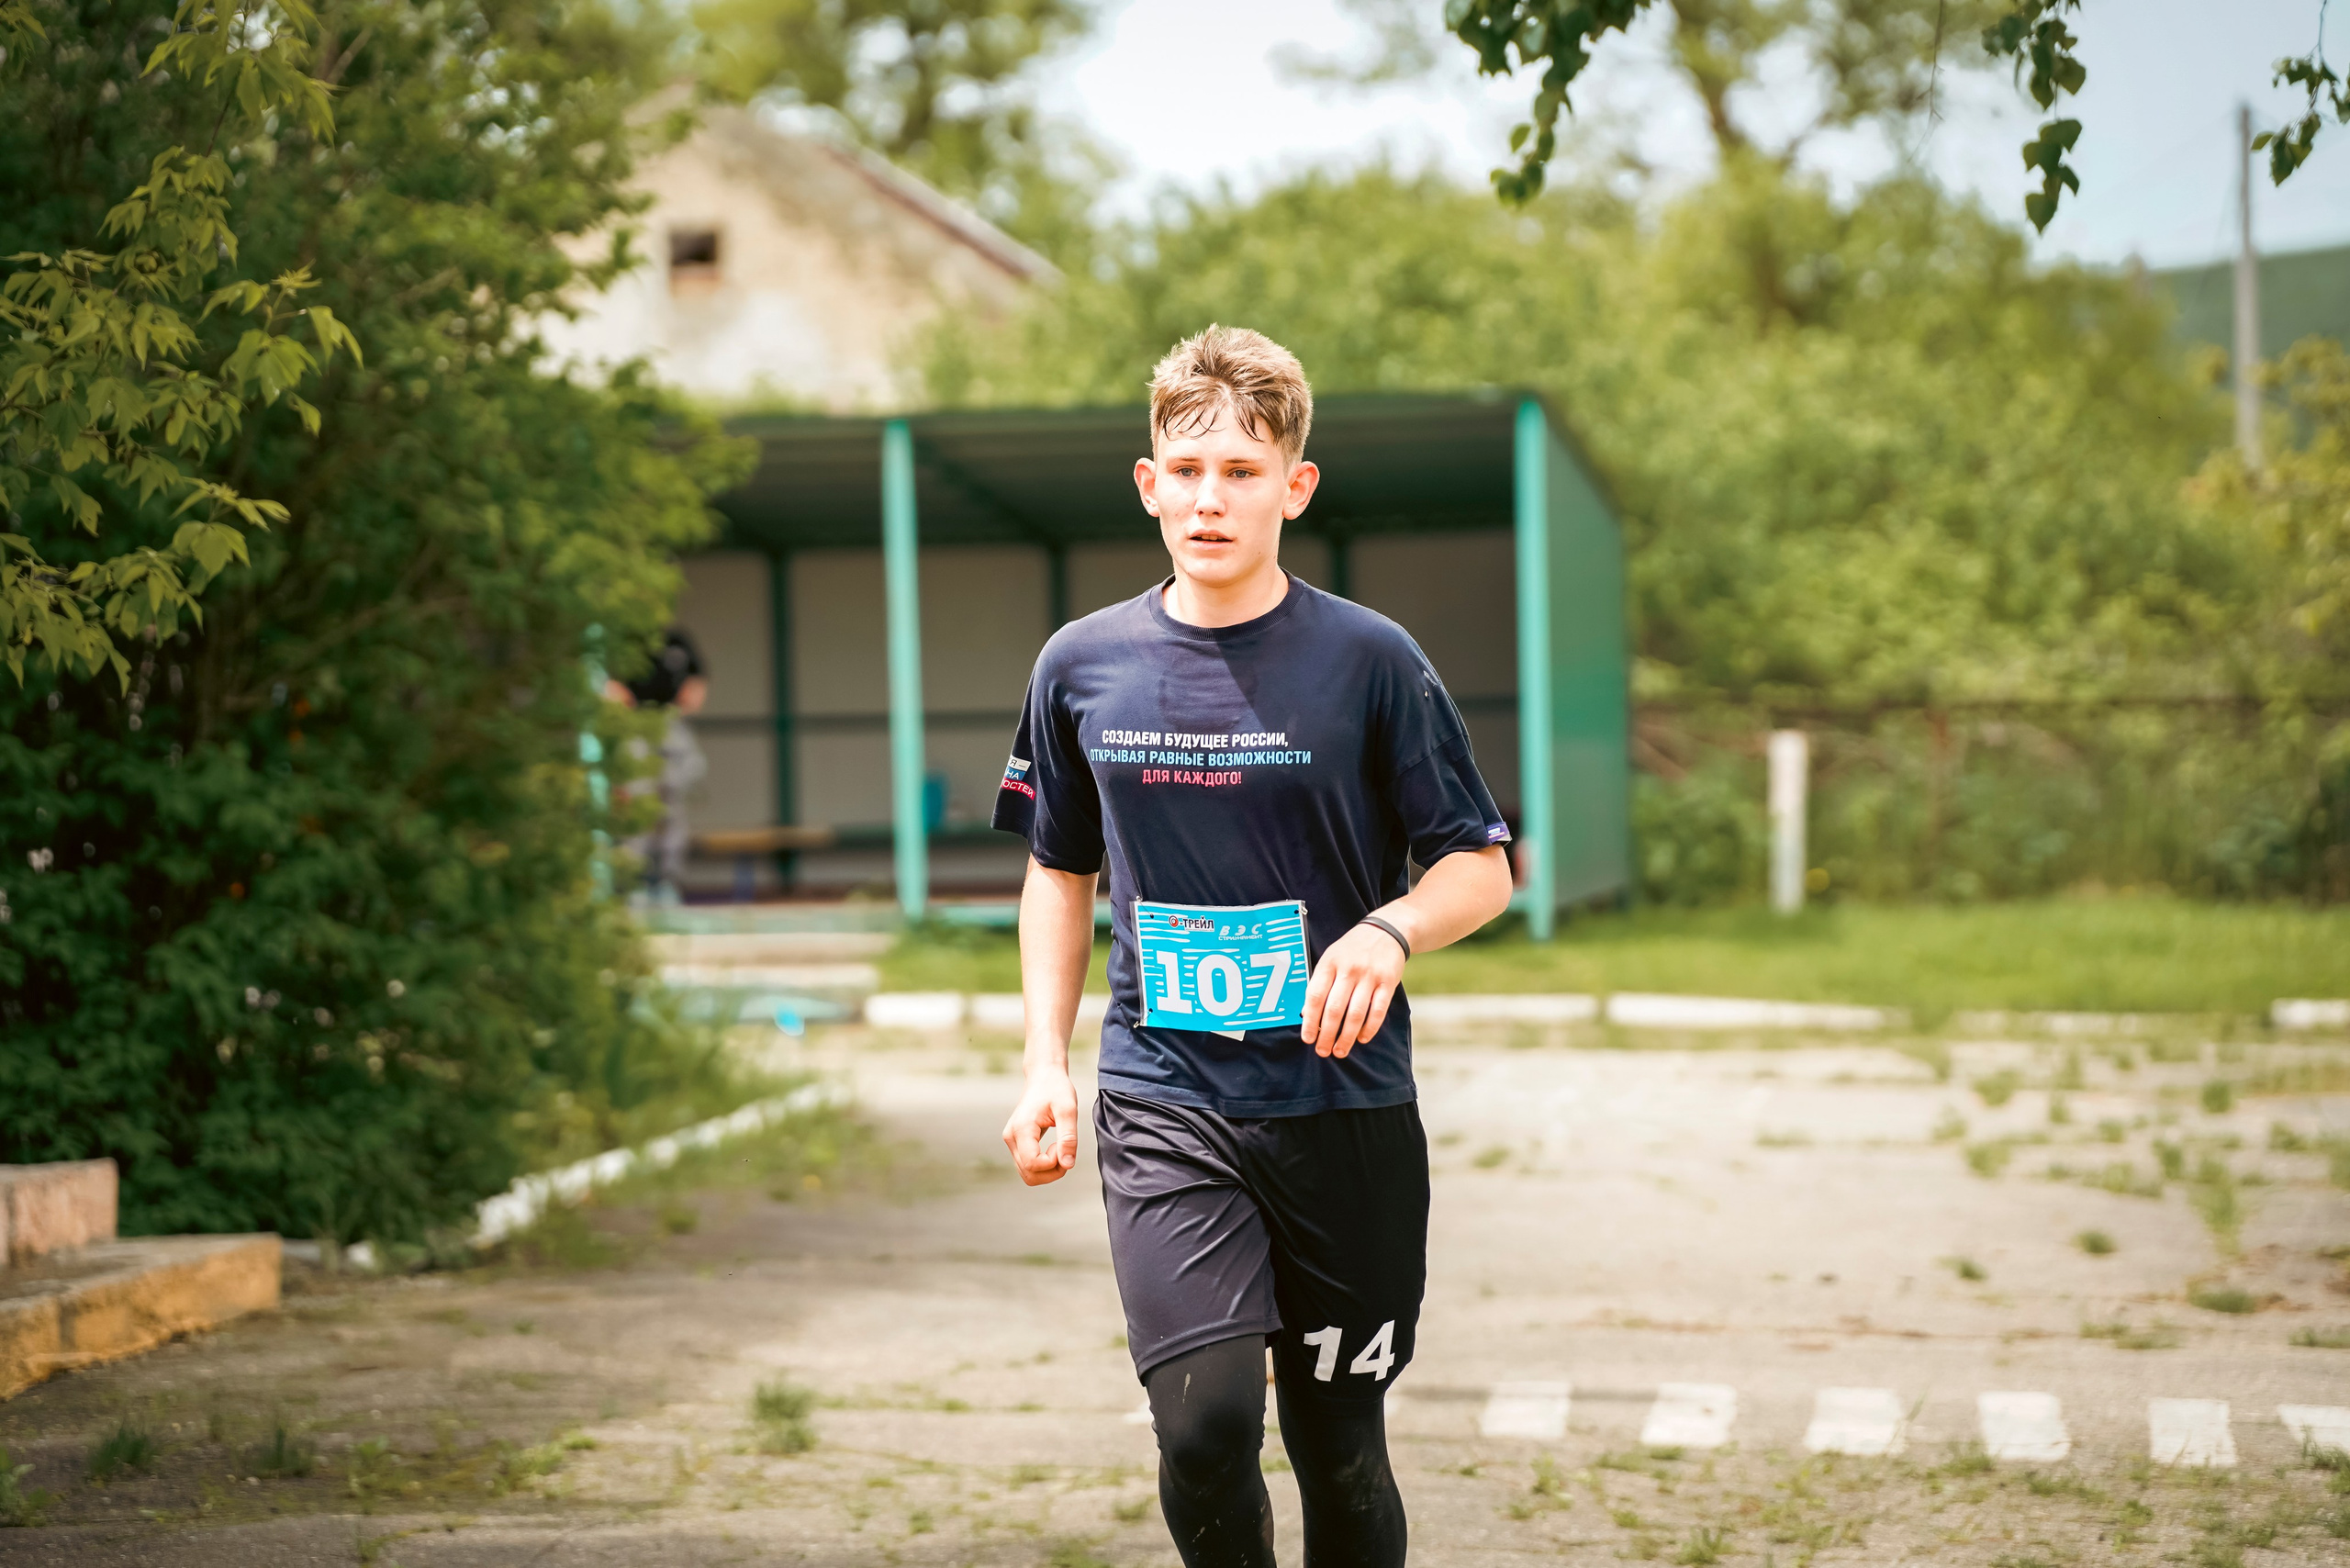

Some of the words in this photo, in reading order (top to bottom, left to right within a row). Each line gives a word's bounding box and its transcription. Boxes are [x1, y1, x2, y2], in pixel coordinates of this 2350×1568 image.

[1102, 730, 1161, 746] СОЗДАЕМ
[1164, 733, 1228, 750] БУДУЩЕЕ
[1231, 732, 1289, 747] РОССИИ,
[1090, 748, 1146, 764] ОТКРЫВАЯ
[1149, 750, 1204, 767] РАВНЫЕ
[1208, 750, 1312, 767] ВОЗМОЖНОСТИ
[1142, 769, 1170, 784] ДЛЯ
[1173, 770, 1242, 788] КАЖДОГО!
[1156, 949, 1292, 1017] 107
[1304, 1319, 1395, 1383] 14
